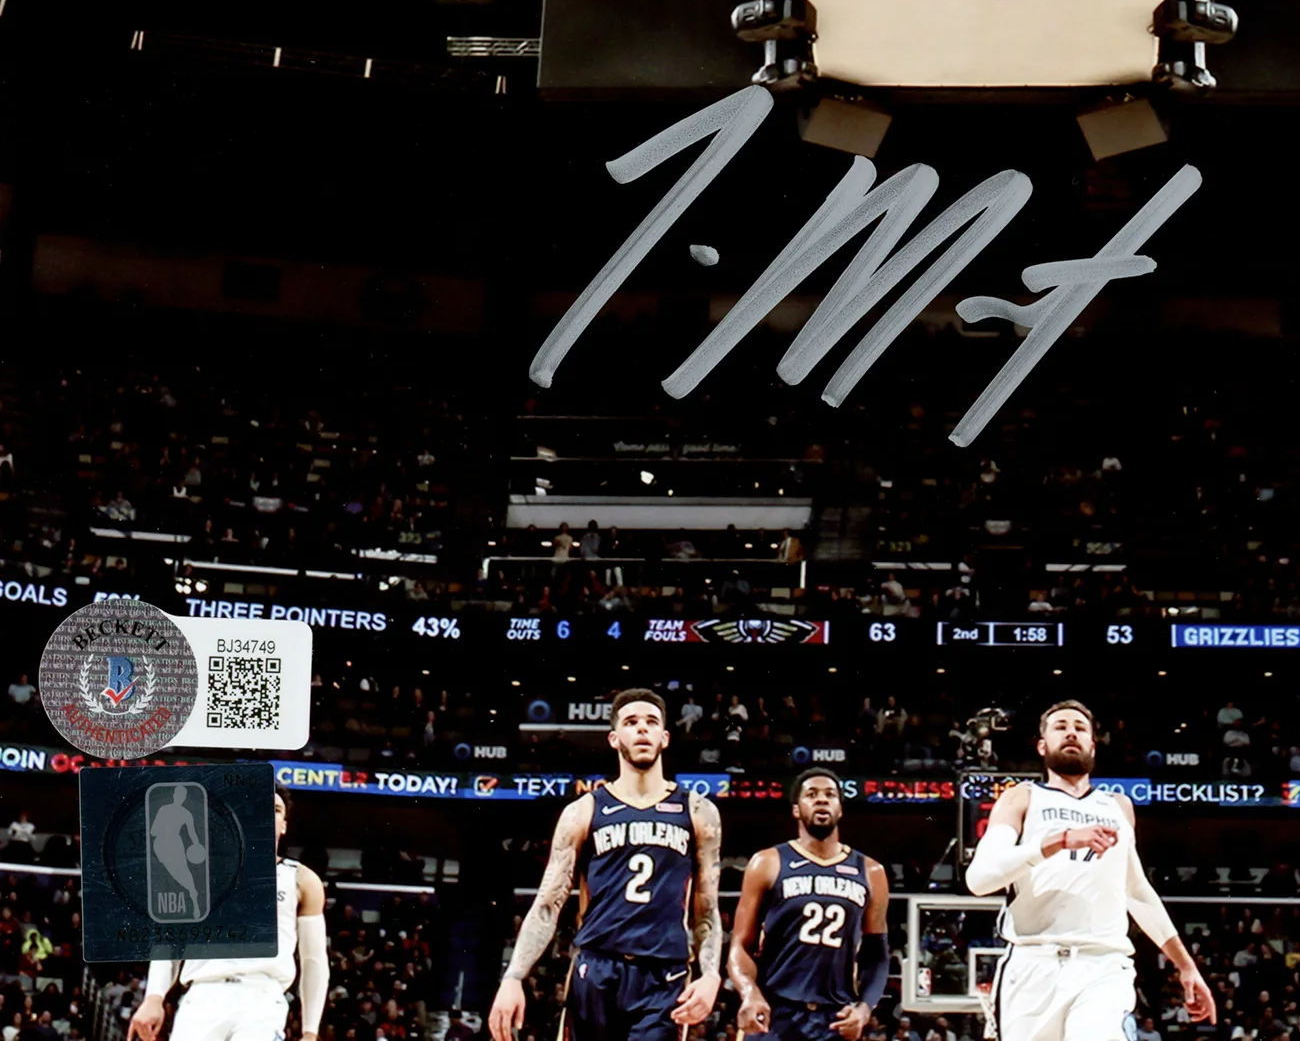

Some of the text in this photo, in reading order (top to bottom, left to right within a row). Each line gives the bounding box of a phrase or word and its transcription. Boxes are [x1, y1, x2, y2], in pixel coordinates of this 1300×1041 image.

[186, 598, 461, 639] THREE POINTERS 43%
[509, 617, 541, 629] TIME
[648, 619, 685, 631] TEAM
[72, 619, 170, 651] BECKETT
[506, 629, 541, 641] OUTS
[556, 620, 570, 639] 6
[607, 621, 621, 639] 4
[644, 630, 687, 642] FOULS
[869, 623, 896, 642] 63
[952, 628, 979, 640] 2nd
[1013, 627, 1047, 642] 1:58
[1106, 625, 1133, 644] 53
[1183, 628, 1300, 646] GRIZZLIES
[217, 639, 276, 655] BJ34749
[61, 703, 172, 744] AUTHENTICATED
[0, 747, 46, 770] OIN
[474, 745, 508, 759] HUB
[812, 749, 846, 762] HUB
[1166, 753, 1199, 766] HUB
[375, 772, 458, 795] TODAY!
[514, 777, 570, 796] TEXT
[1131, 783, 1264, 802] CHECKLIST?
[1042, 807, 1121, 831] MEMPHIS
[593, 821, 691, 856] NEW ORLEANS
[624, 853, 654, 903] 2
[782, 875, 868, 908] NEW ORLEANS
[157, 891, 186, 914] NBA
[799, 901, 846, 949] 22
